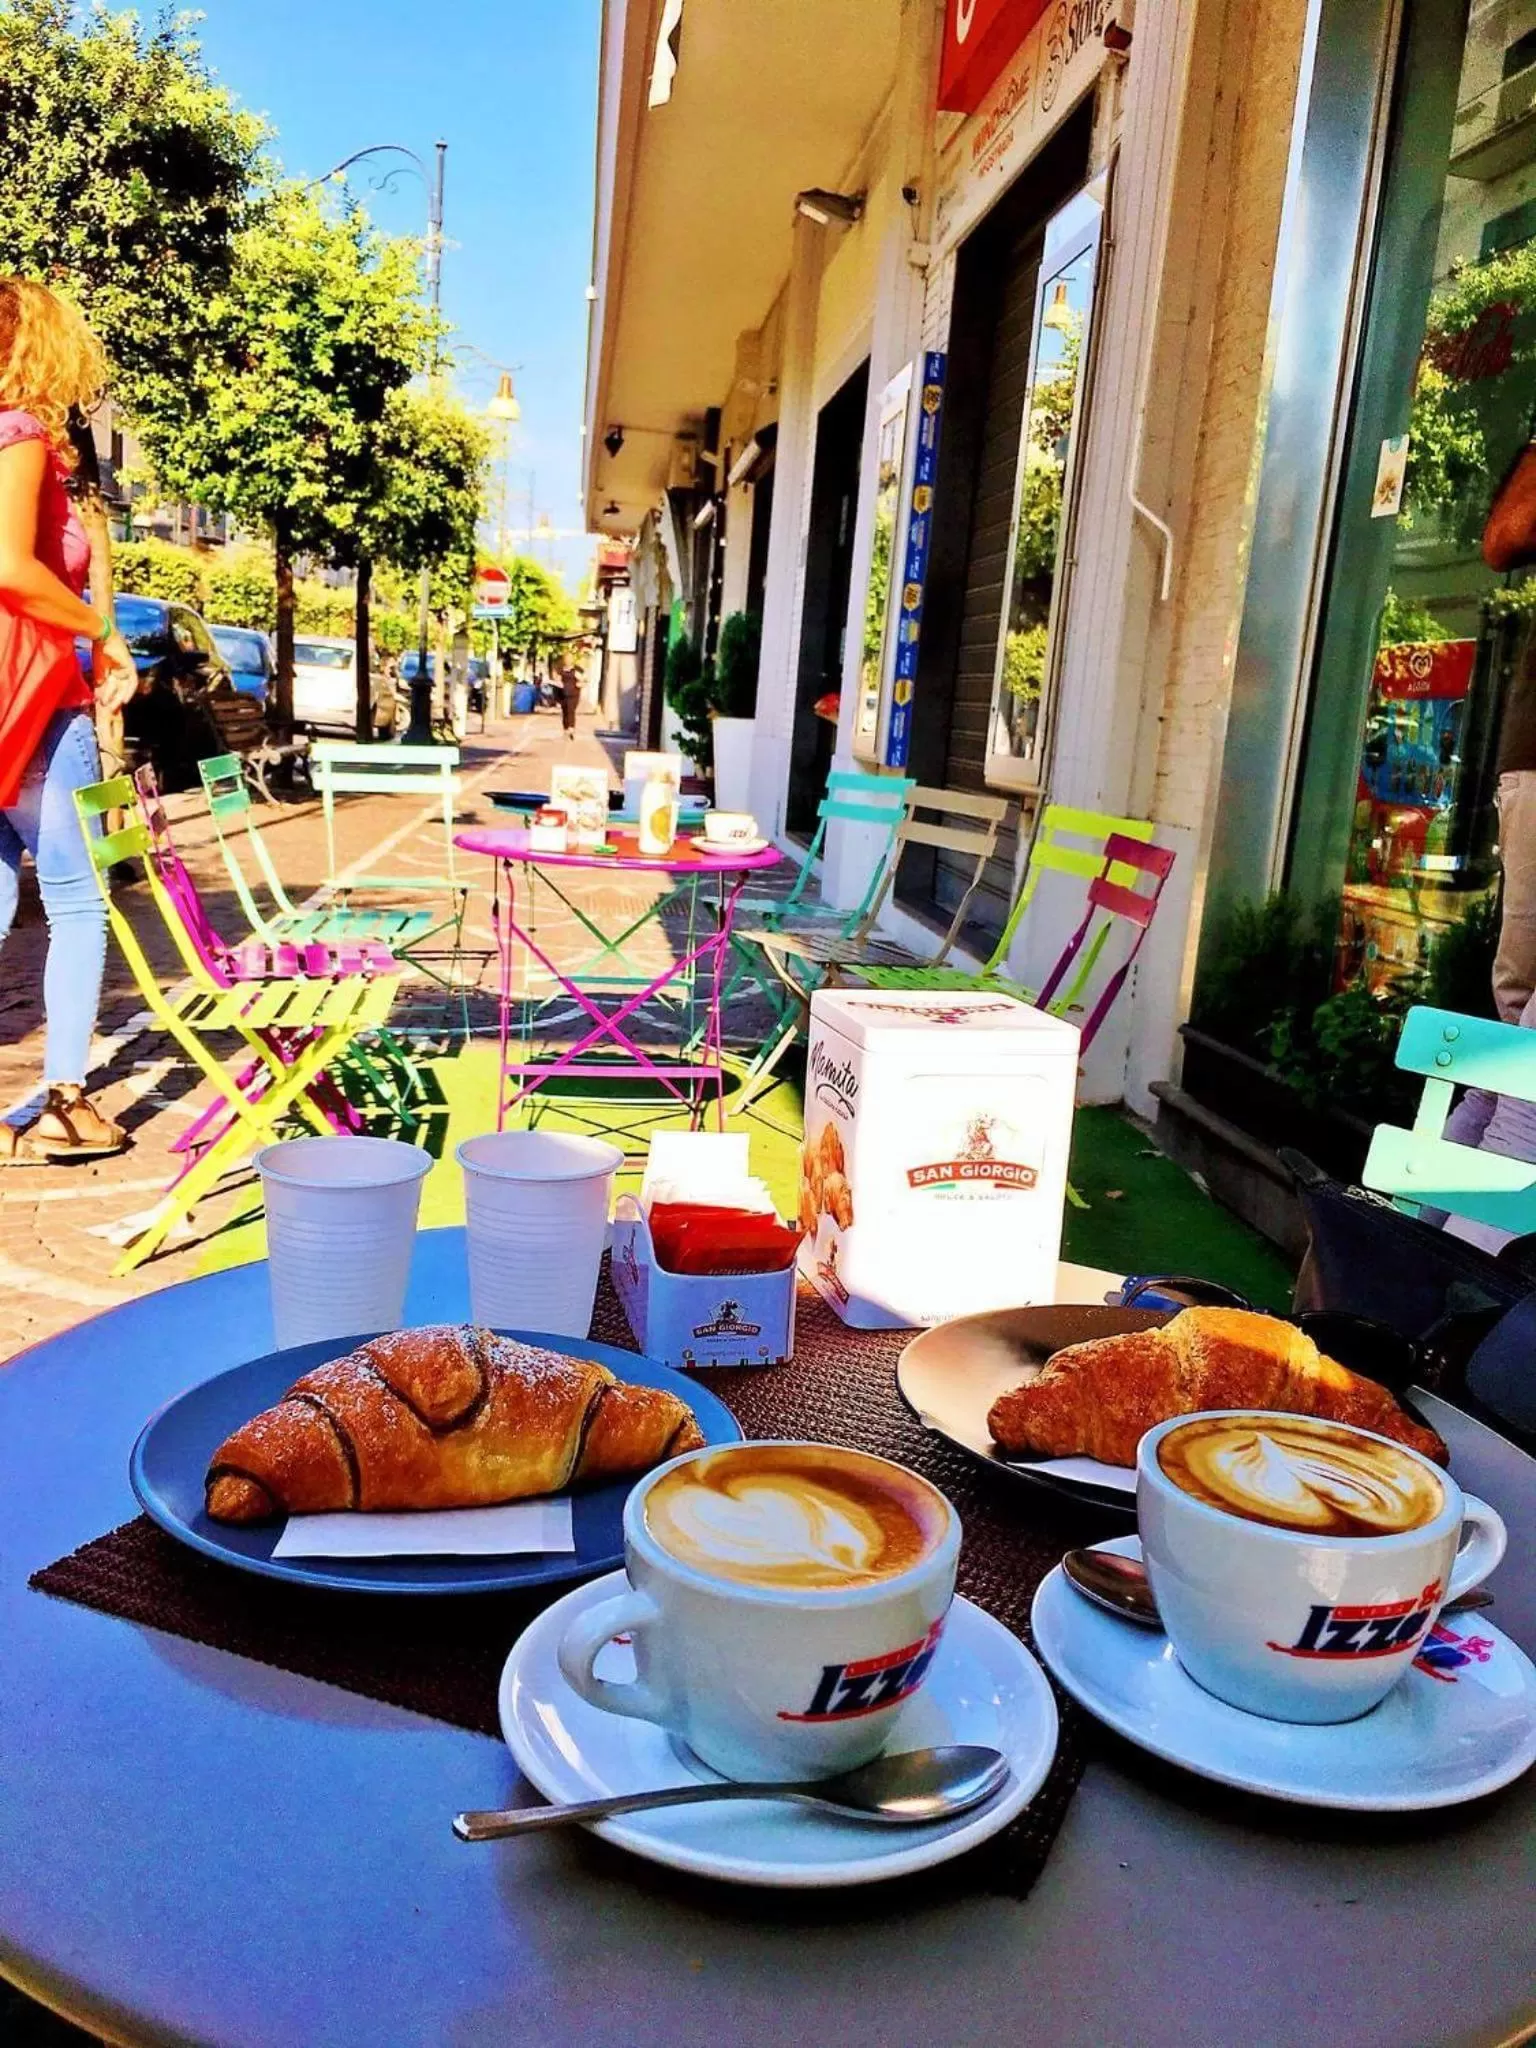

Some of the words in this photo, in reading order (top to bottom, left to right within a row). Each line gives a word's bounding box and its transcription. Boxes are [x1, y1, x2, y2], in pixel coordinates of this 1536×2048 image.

[912, 1164, 953, 1183] SAN
[959, 1163, 1034, 1182] GIORGIO
[695, 1325, 717, 1335] SAN
[718, 1323, 759, 1334] GIORGIO
